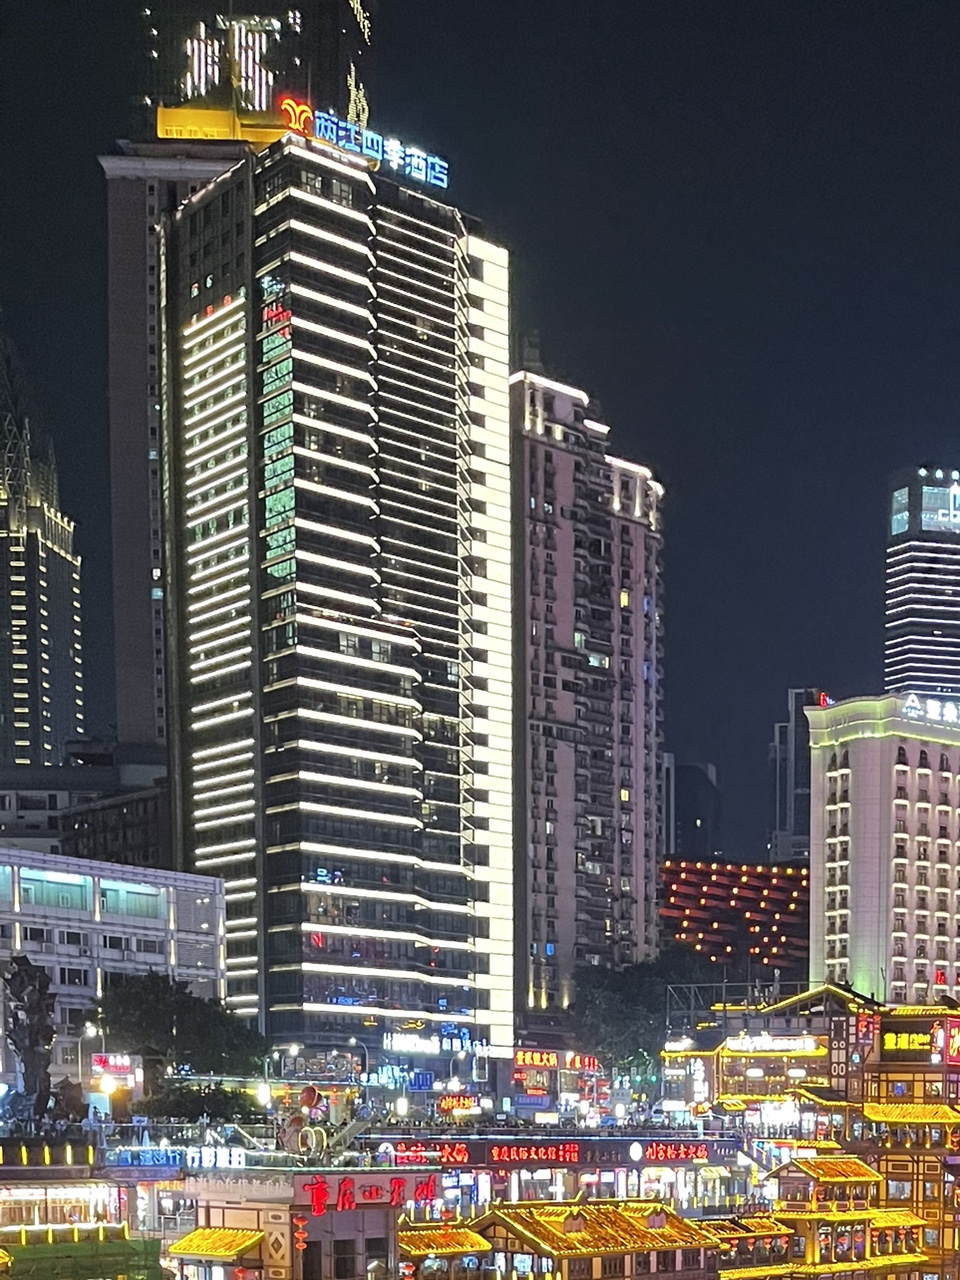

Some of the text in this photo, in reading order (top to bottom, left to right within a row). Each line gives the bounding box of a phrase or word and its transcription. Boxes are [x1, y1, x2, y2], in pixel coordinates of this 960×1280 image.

[314, 110, 449, 189] 两江四季酒店
